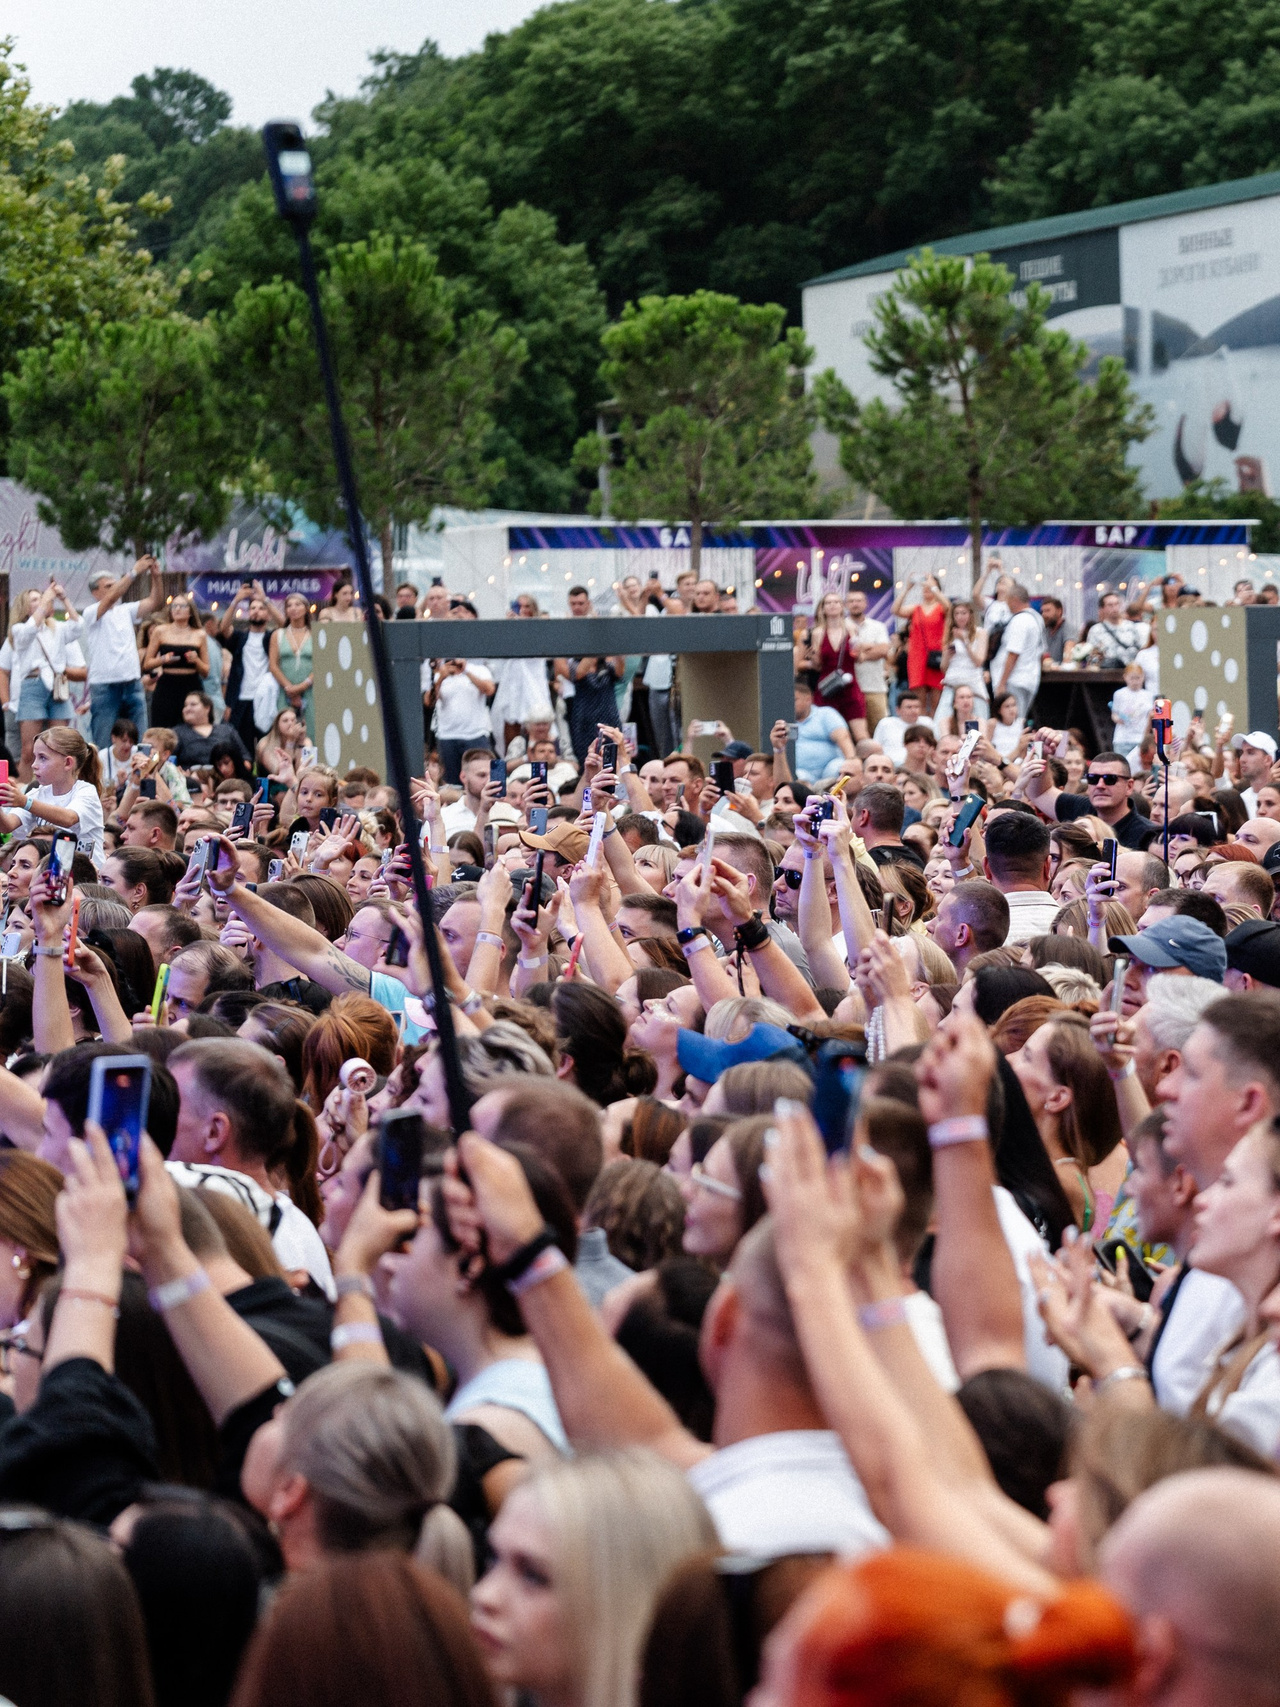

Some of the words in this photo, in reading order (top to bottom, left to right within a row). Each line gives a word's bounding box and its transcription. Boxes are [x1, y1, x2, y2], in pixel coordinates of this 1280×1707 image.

[659, 527, 692, 547] БА
[1095, 525, 1138, 545] БАР
[266, 580, 278, 593] И
[280, 578, 321, 593] ХЛЕБ
